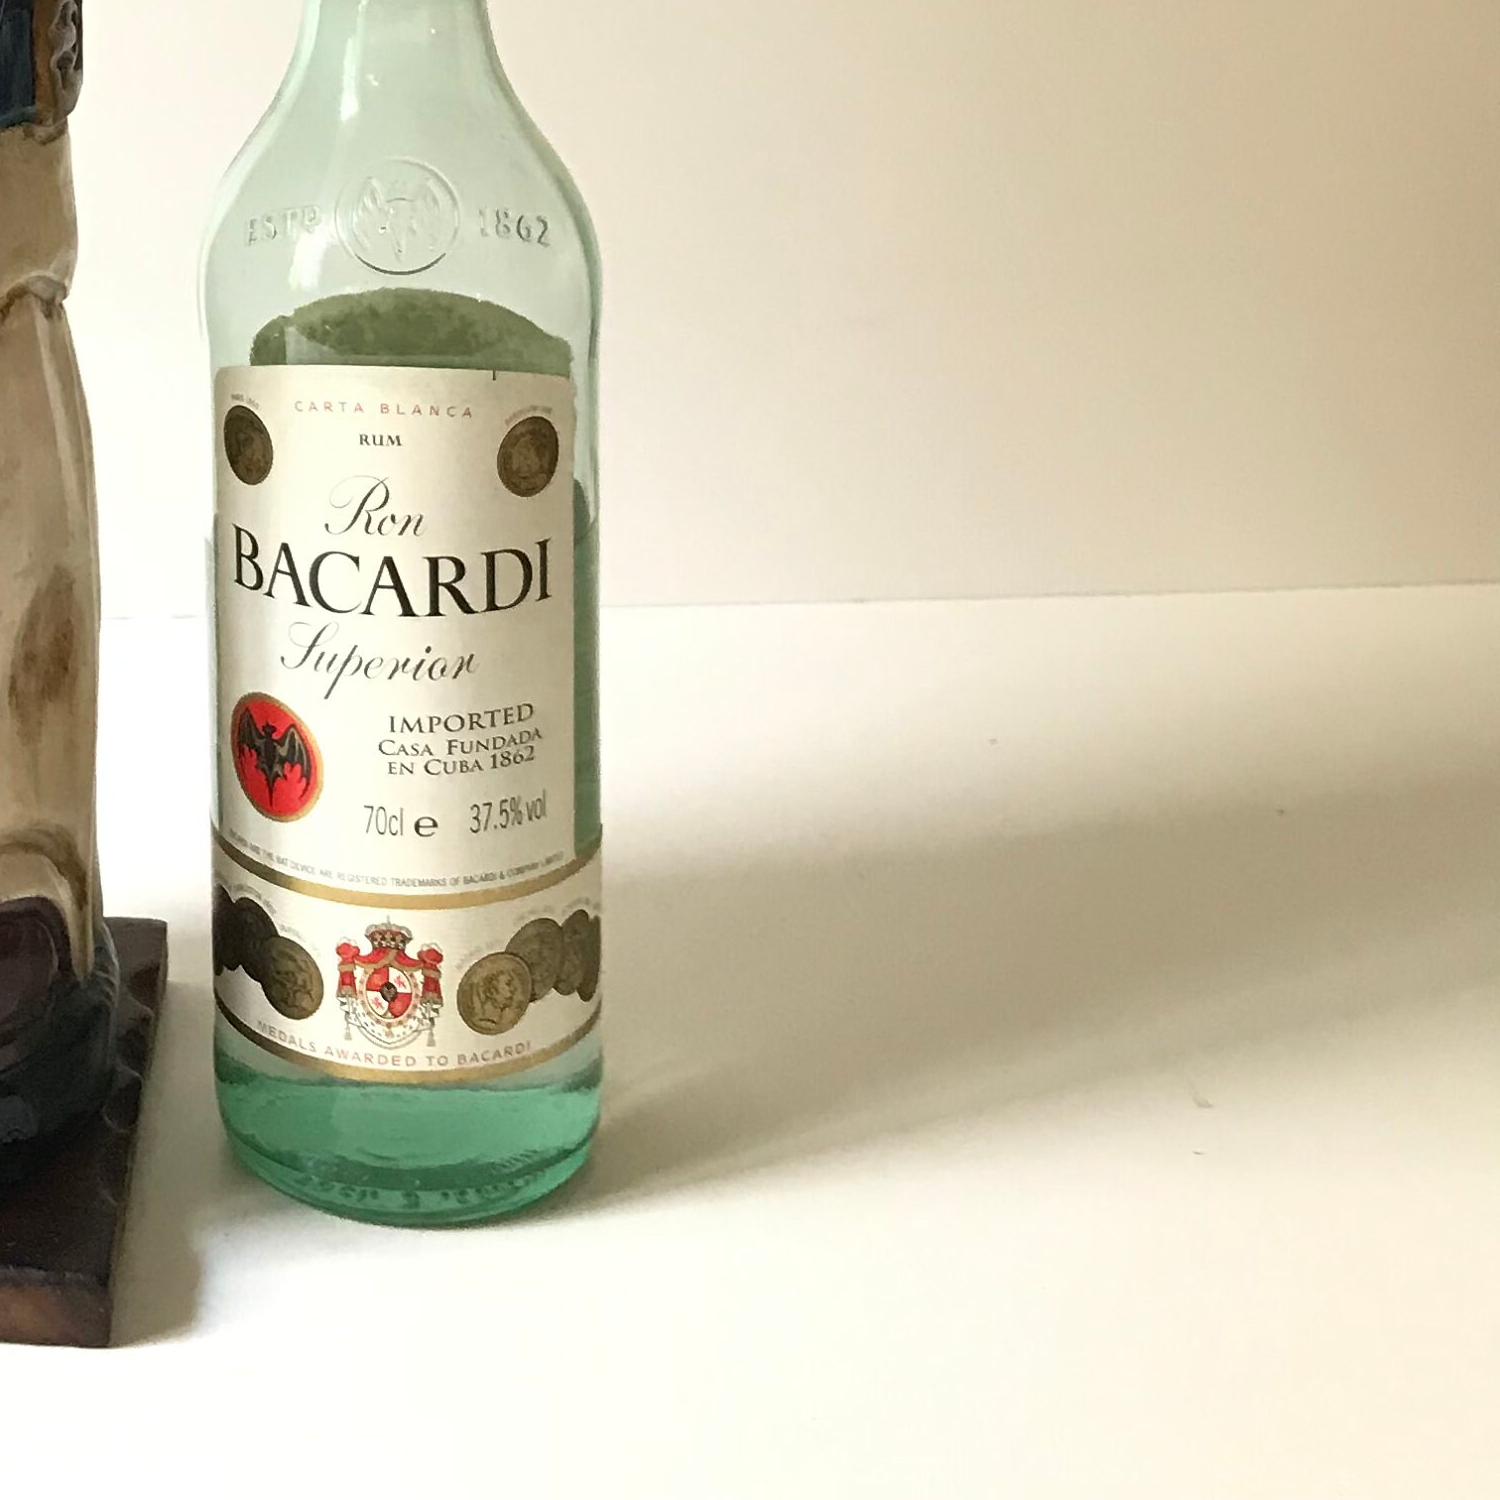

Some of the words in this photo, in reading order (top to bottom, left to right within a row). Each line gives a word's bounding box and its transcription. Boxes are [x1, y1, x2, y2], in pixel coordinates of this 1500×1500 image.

[478, 205, 552, 249] 1862
[293, 400, 365, 415] CARTA
[379, 402, 473, 419] BLANCA
[358, 433, 403, 448] RUM
[324, 474, 427, 538] Ron
[231, 522, 553, 619] BACARDI
[279, 620, 480, 700] Superior
[388, 702, 535, 735] IMPORTED
[387, 761, 416, 776] EN
[489, 744, 536, 770] 1862
[363, 804, 404, 837] 70cl
[525, 787, 548, 822] vol
[336, 871, 388, 887] REGISTERED
[391, 876, 447, 888] TRADEMARKS
[450, 876, 462, 887] OF
[256, 1019, 317, 1053] MEDALS
[323, 1047, 417, 1068] AWARDED
[426, 1054, 449, 1067] TO
[457, 1040, 532, 1066] BACARDI
